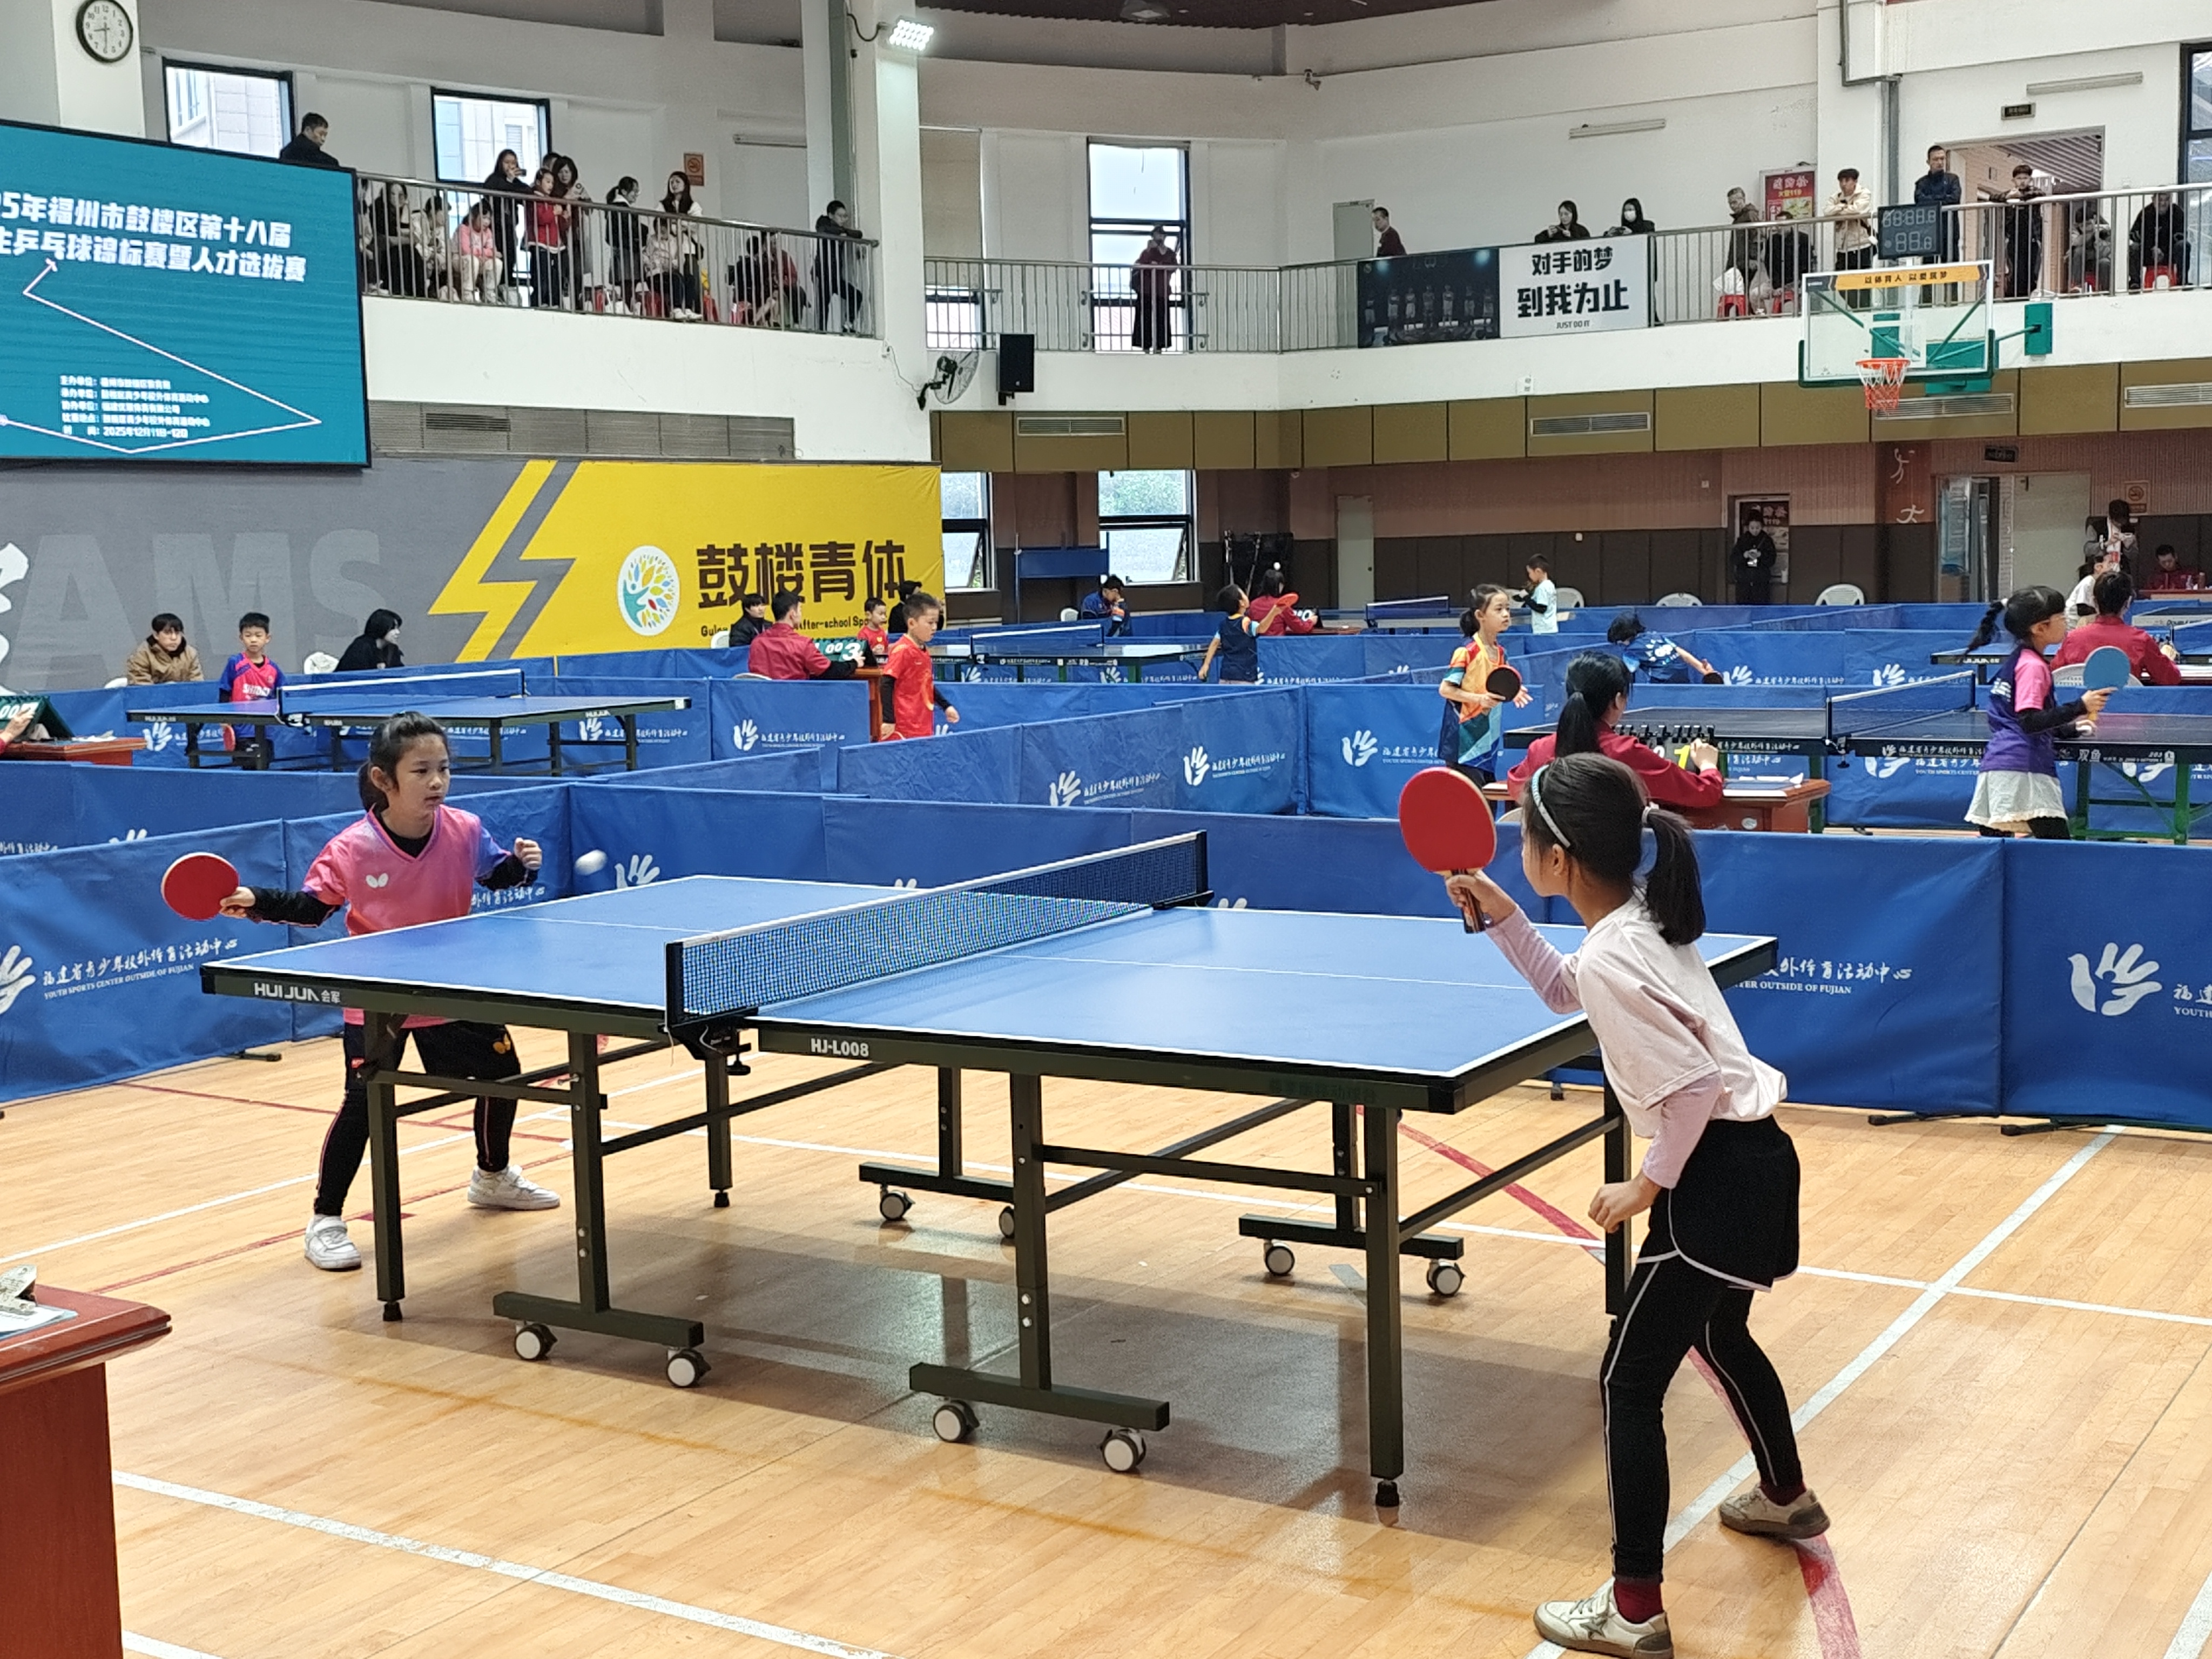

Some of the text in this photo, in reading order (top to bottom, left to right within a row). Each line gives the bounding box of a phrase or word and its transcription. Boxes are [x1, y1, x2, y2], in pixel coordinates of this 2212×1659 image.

[0, 191, 291, 248] 5年福州市鼓楼区第十八届
[1532, 246, 1614, 276] 对手的梦
[1517, 279, 1629, 319] 到我为止
[697, 539, 905, 609] 鼓楼青体
[853, 615, 868, 628] Spo
[1674, 745, 1690, 769] 1
[1728, 754, 1782, 766] 育活动中心
[2078, 748, 2101, 762] 双鱼
[43, 938, 238, 986] 福建省青少年校外体育活动中心
[44, 988, 68, 1000] YOUTH
[69, 983, 96, 994] SPORTS
[97, 977, 124, 989] CENTER
[125, 970, 156, 983] OUTSIDE
[168, 963, 194, 974] FUJIAN
[254, 982, 320, 1001] HUIJUN
[1735, 980, 1852, 995] TER OUTSIDE OF FUJIAN
[811, 1038, 869, 1057] HJ-L008
